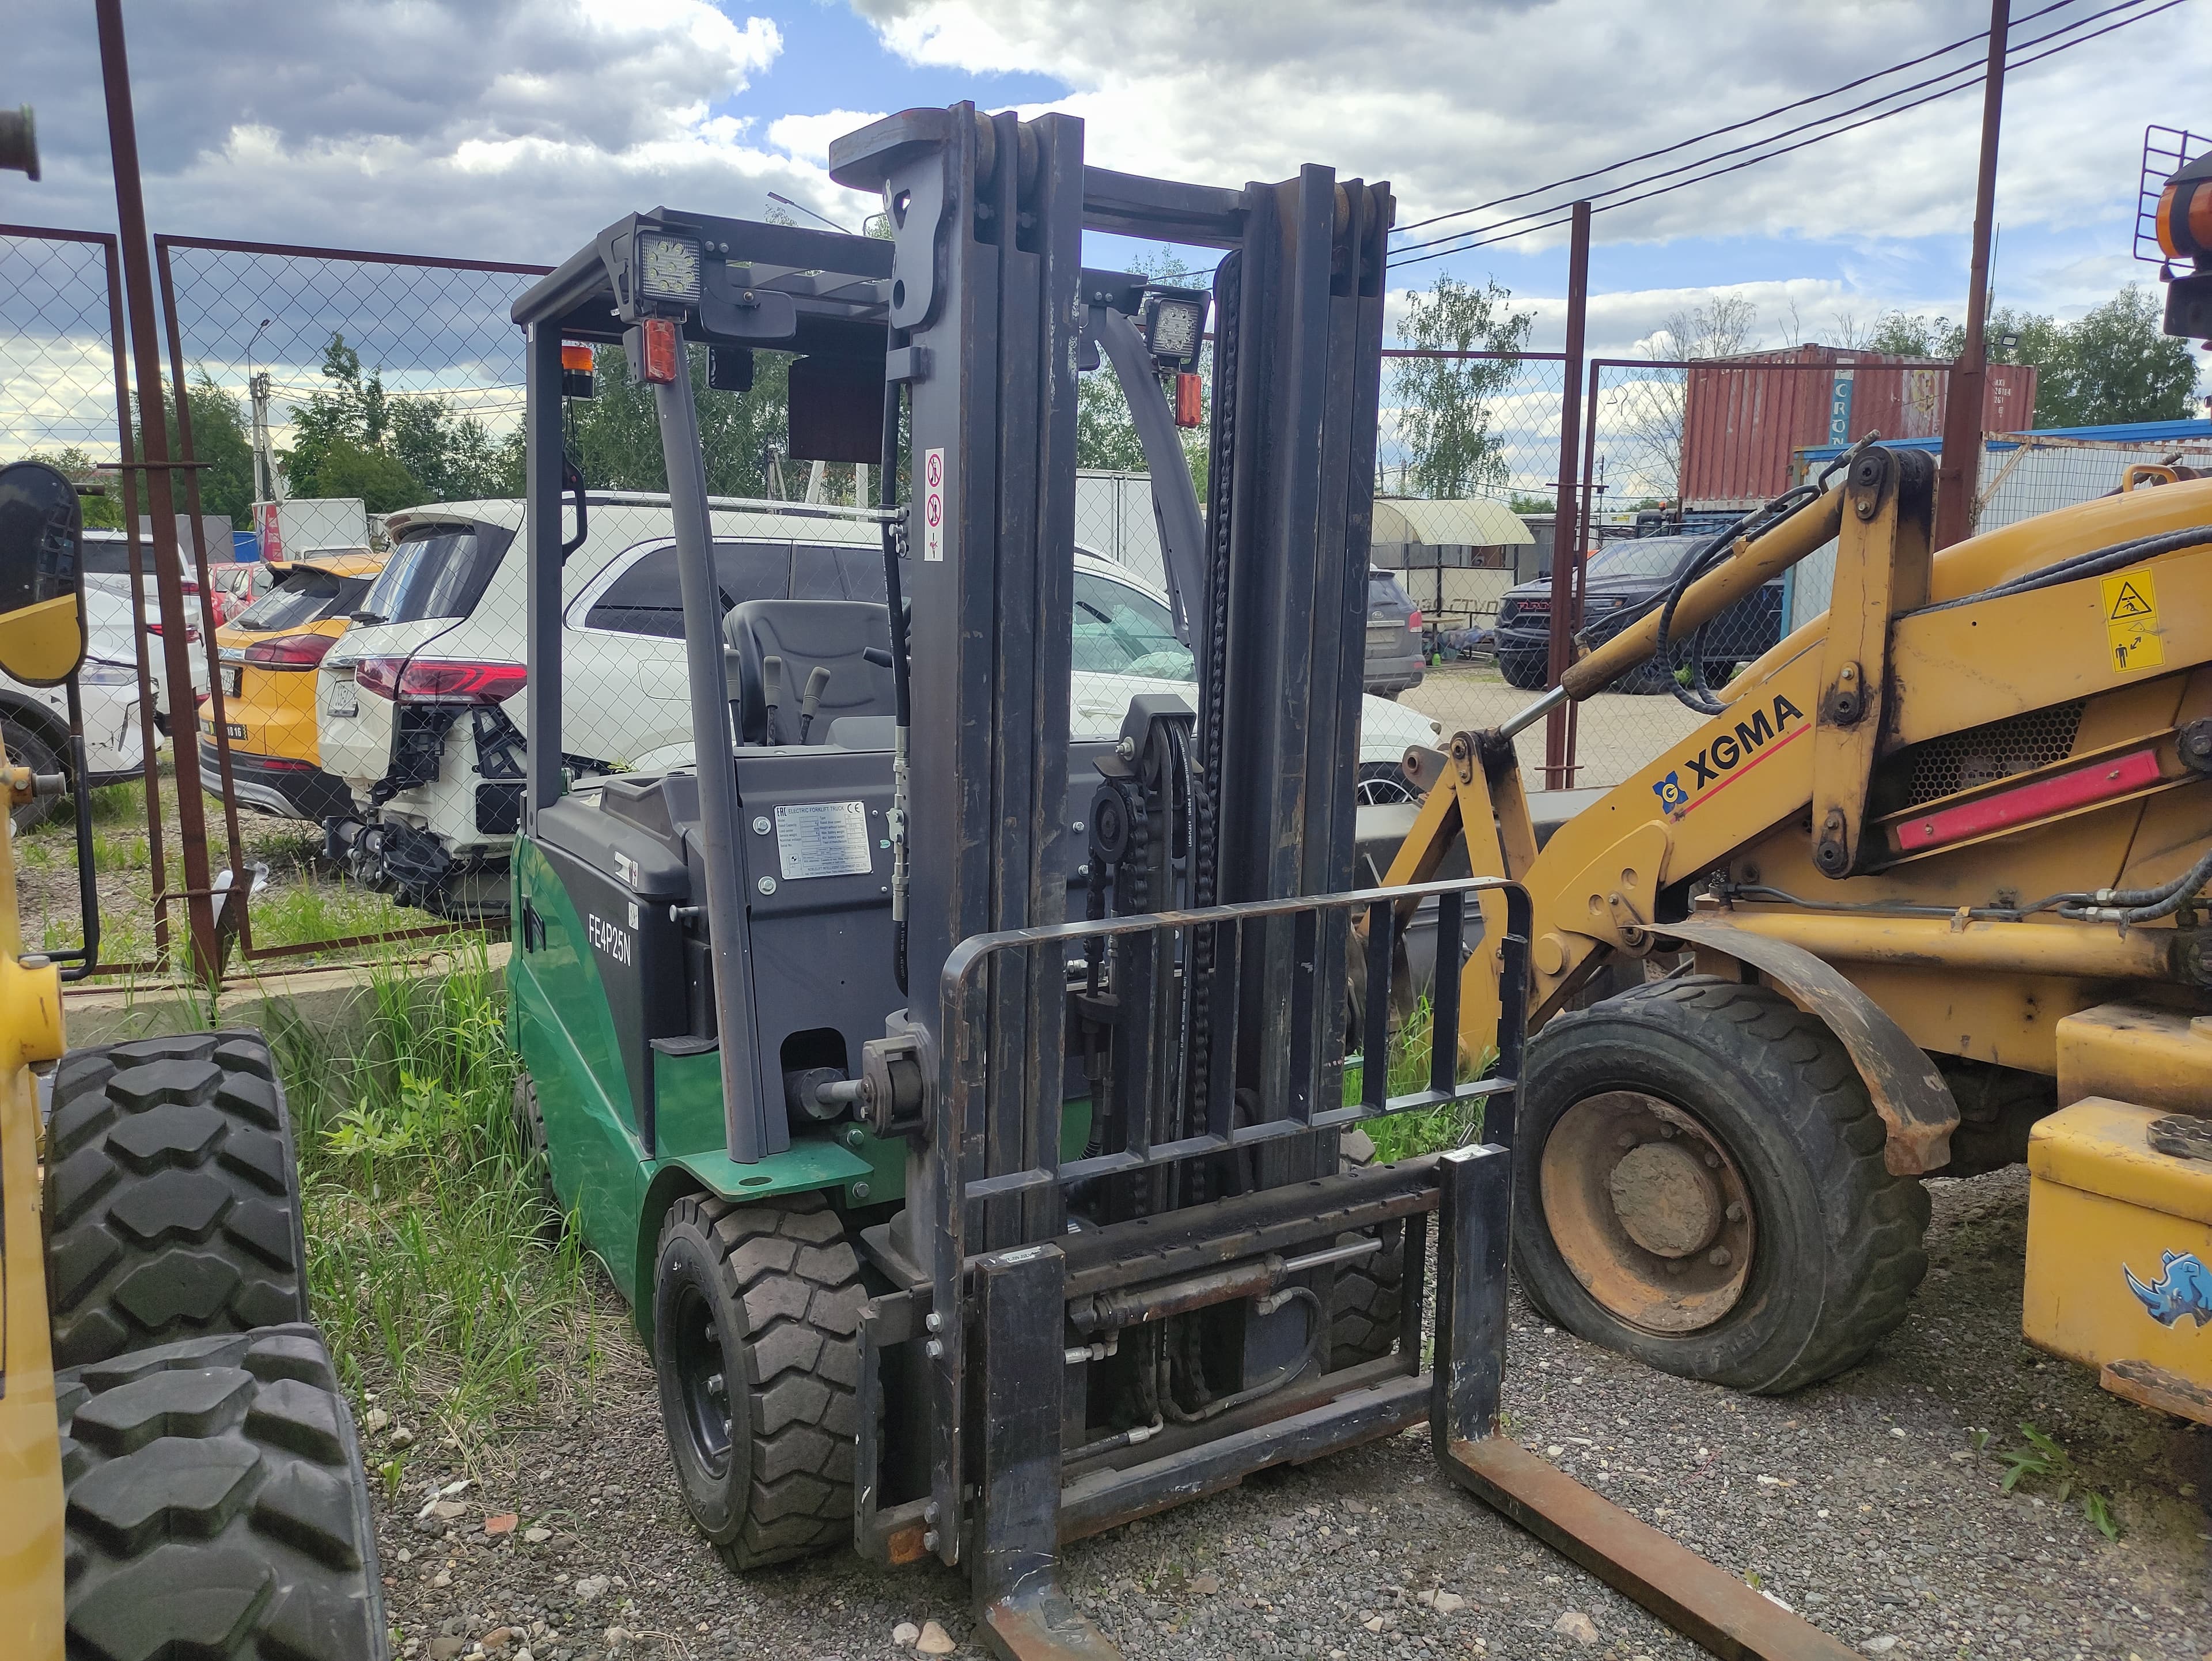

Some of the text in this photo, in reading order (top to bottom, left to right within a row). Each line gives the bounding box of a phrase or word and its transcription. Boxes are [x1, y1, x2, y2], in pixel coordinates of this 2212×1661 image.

[234, 727, 242, 737] 16
[1684, 694, 1804, 791] XGMA
[847, 803, 860, 814] CE
[589, 913, 631, 967] FE4P25N
